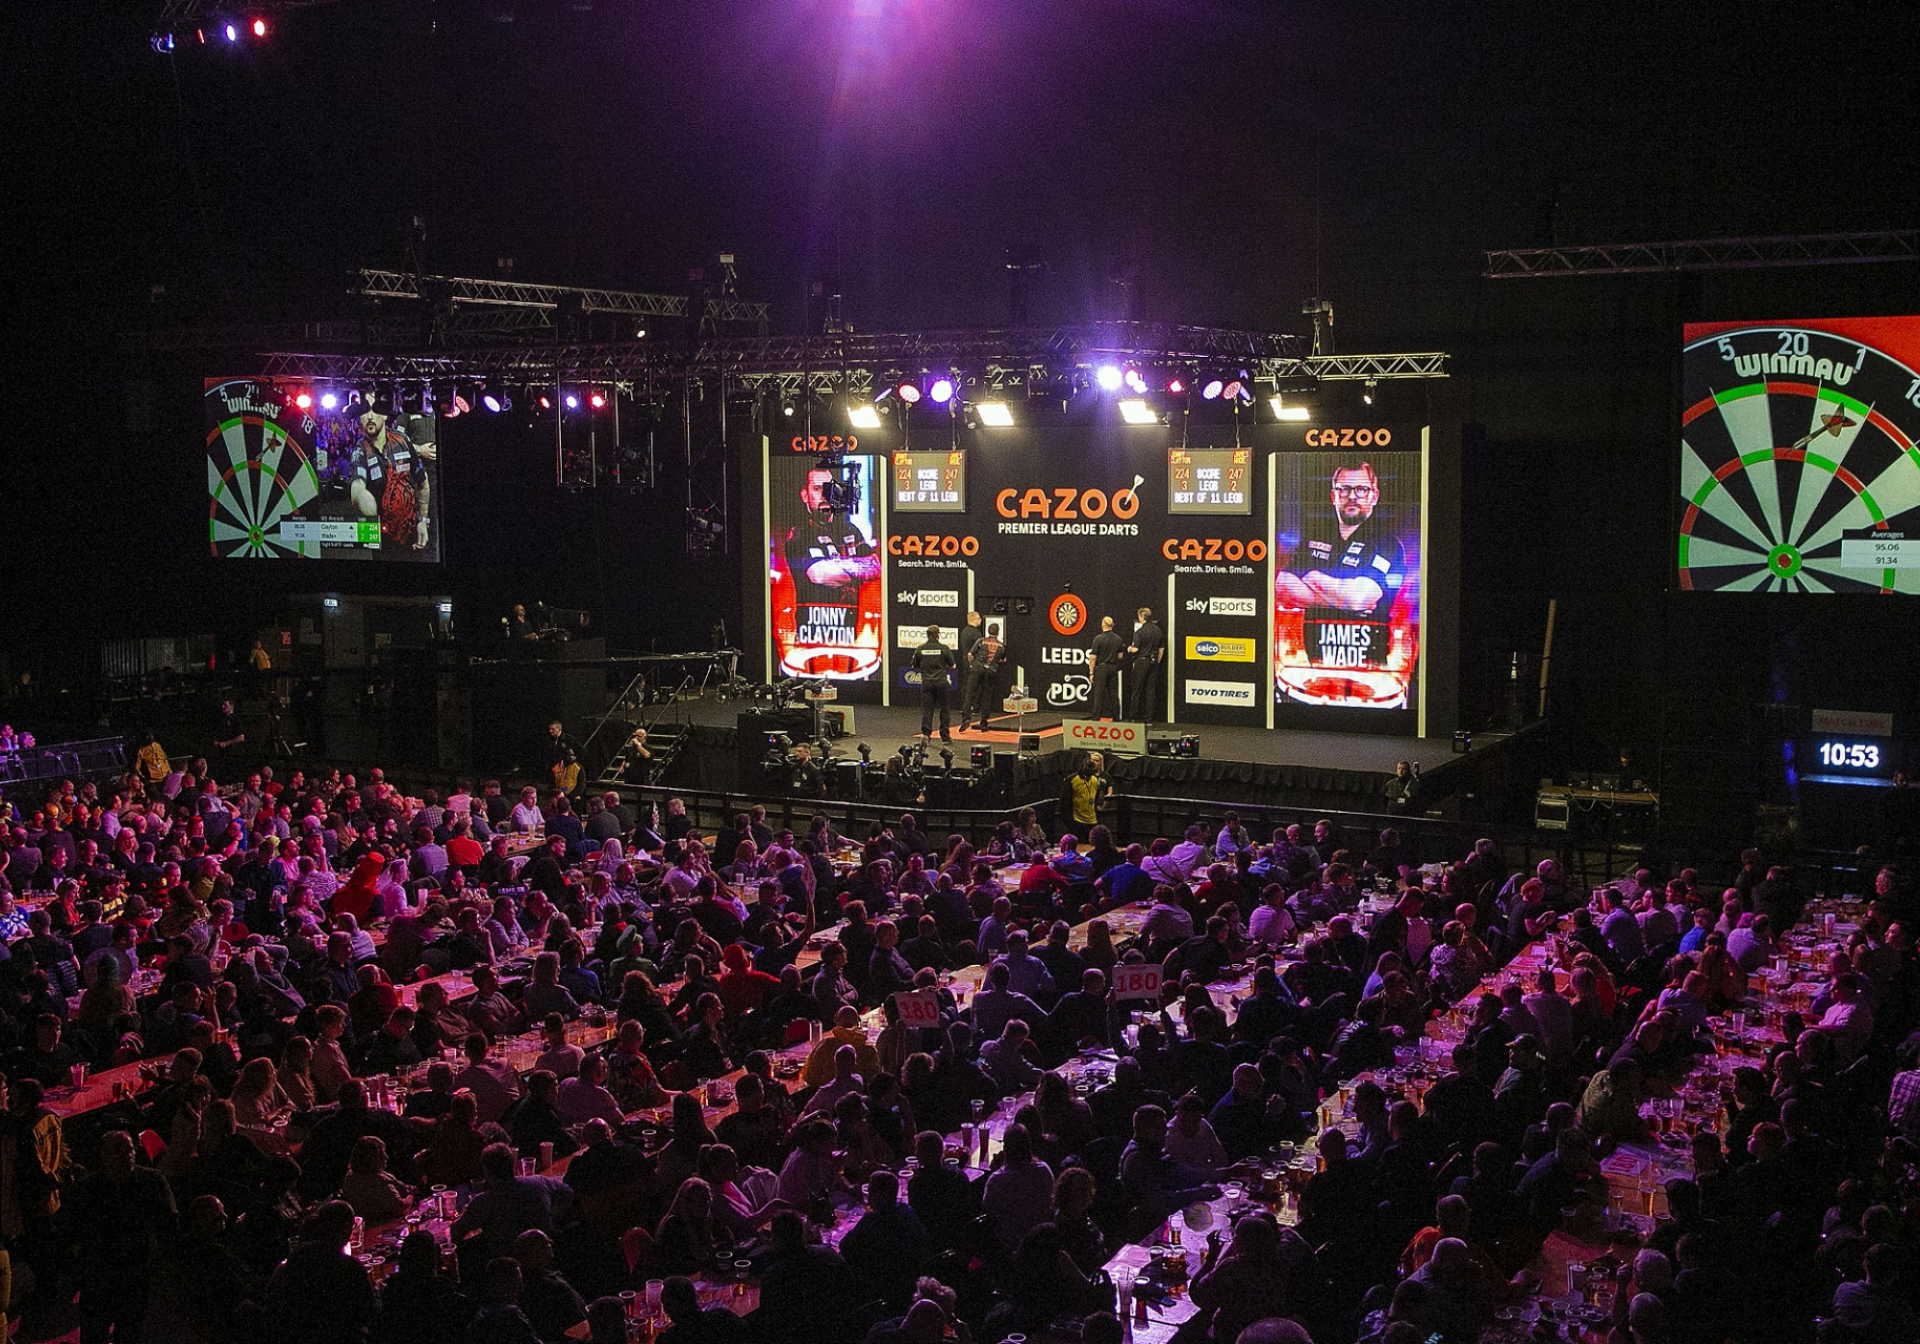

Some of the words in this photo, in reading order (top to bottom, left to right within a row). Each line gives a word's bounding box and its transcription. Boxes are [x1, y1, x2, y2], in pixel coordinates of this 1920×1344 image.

[1717, 337, 1735, 361] 5
[1778, 332, 1809, 355] 20
[1853, 347, 1866, 374] 1
[219, 387, 228, 402] 5
[301, 415, 314, 434] 18
[1305, 428, 1392, 447] CAZOO
[897, 469, 912, 479] 224
[944, 469, 958, 479] 247
[1174, 468, 1190, 479] 224
[1228, 468, 1244, 479] 247
[904, 481, 910, 490] 3
[946, 481, 953, 490] 2
[1181, 481, 1188, 491] 3
[1230, 481, 1237, 491] 2
[995, 487, 1140, 520] CAZOO
[1196, 493, 1207, 503] OF
[1210, 493, 1221, 504] 11
[998, 523, 1048, 534] PREMIER
[1050, 523, 1097, 535] LEAGUE
[1099, 524, 1139, 536] DARTS
[1870, 531, 1904, 539] Averages
[888, 535, 979, 556] CAZOO
[1162, 539, 1267, 561] CAZOO
[1875, 543, 1899, 551] 95.06
[897, 591, 917, 605] sky
[920, 593, 956, 604] sports
[1186, 597, 1208, 613] sky
[1212, 601, 1254, 612] sports
[808, 606, 847, 626] JONNY
[799, 625, 855, 645] CLAYTON
[1318, 623, 1371, 646] JAMES
[1196, 644, 1219, 653] selco
[1321, 645, 1368, 668] WADE
[1051, 682, 1088, 701] PDC
[1191, 688, 1218, 697] TOYO
[1219, 690, 1249, 698] TIRES
[1072, 725, 1135, 741] CAZOO
[1820, 742, 1879, 768] 10:53
[1115, 971, 1158, 992] 180
[899, 1001, 937, 1019] 180
